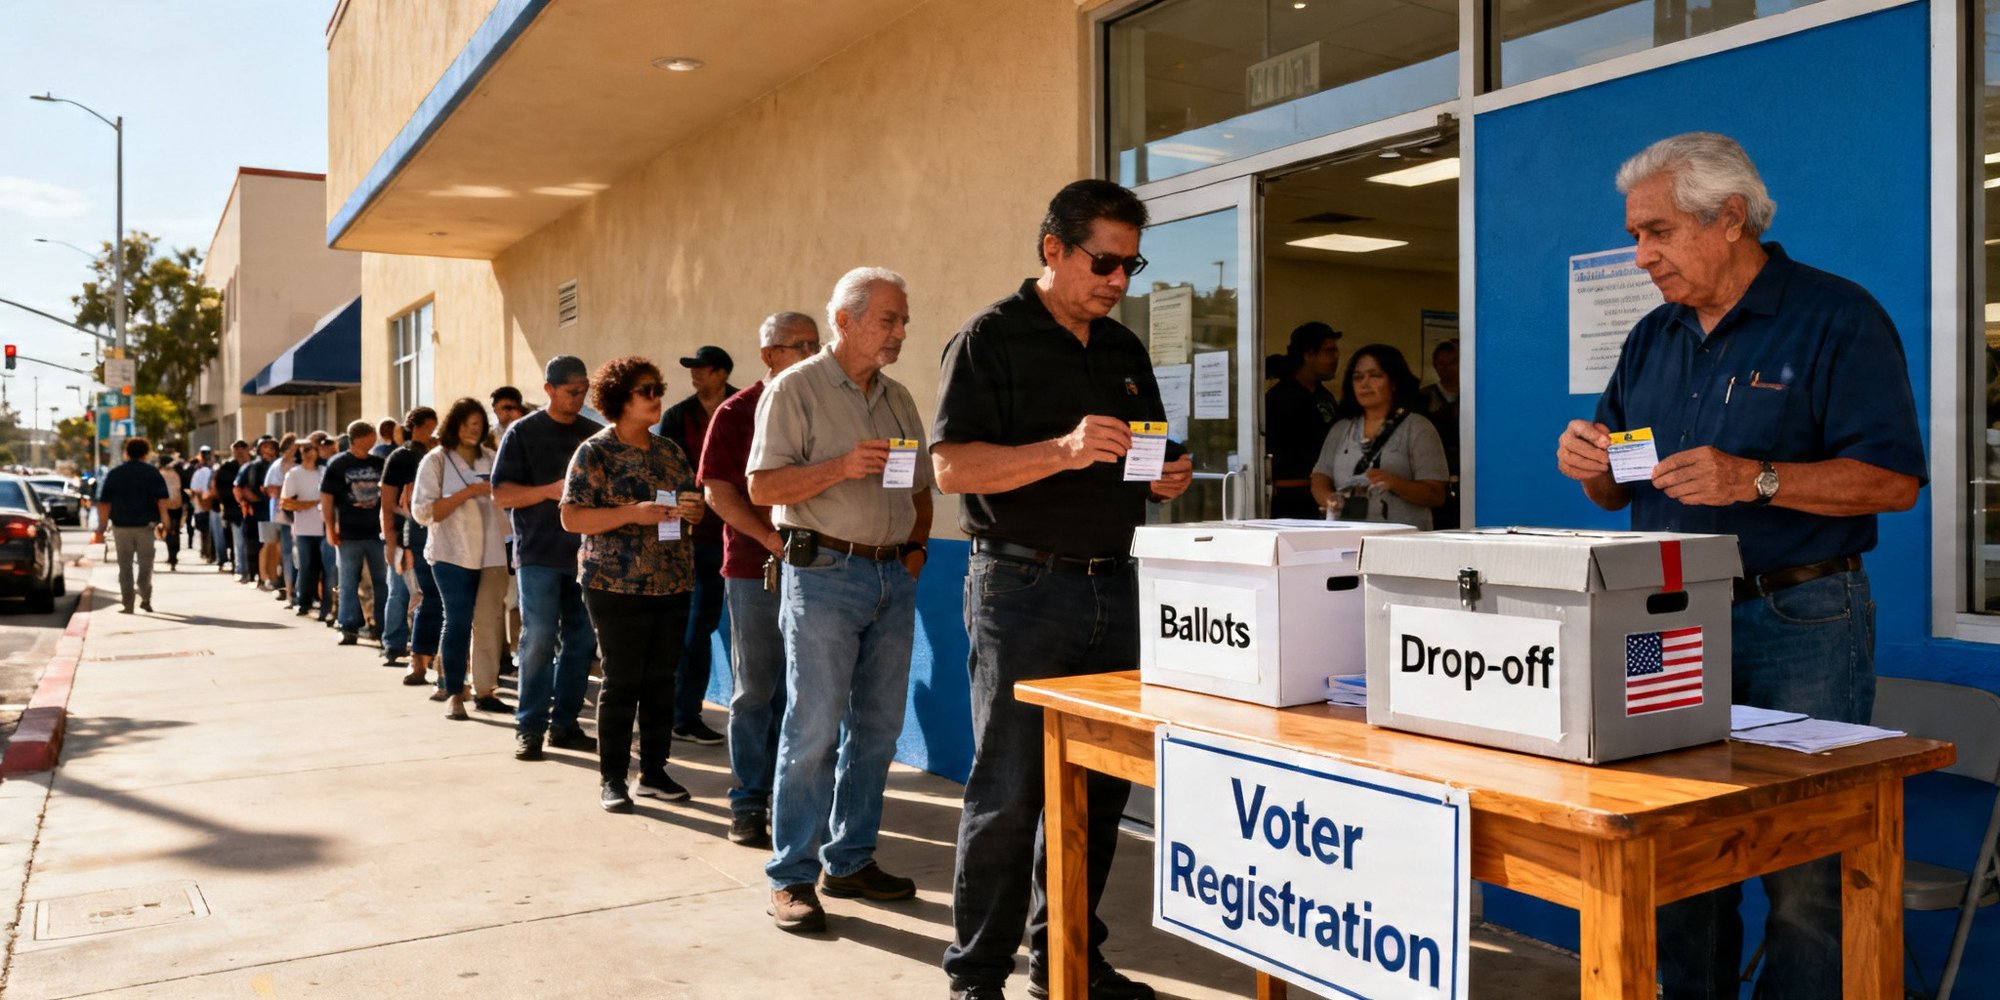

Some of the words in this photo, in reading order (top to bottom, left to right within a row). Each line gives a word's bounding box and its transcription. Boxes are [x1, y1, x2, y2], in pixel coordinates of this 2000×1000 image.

[1160, 603, 1251, 650] Ballots
[1401, 633, 1555, 692] Drop-off
[1230, 776, 1364, 871] Voter
[1170, 840, 1440, 990] Registration
